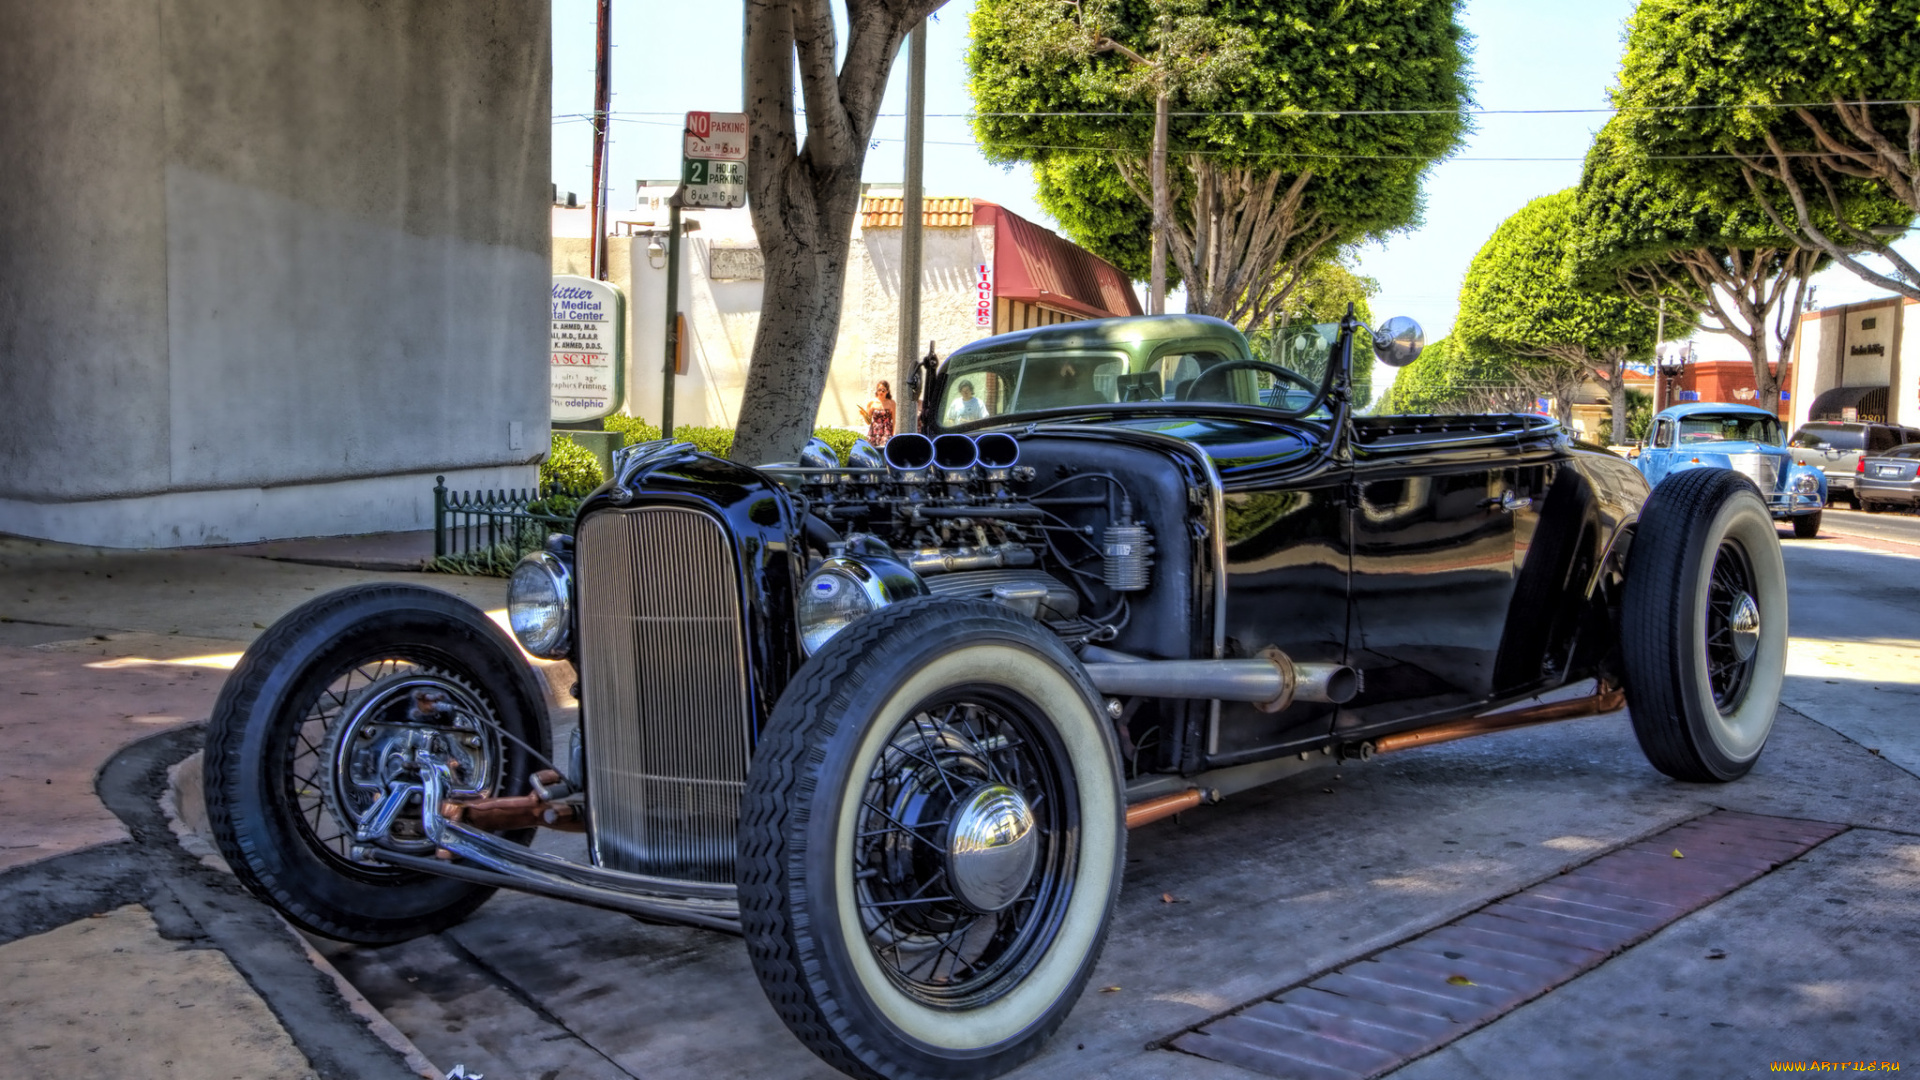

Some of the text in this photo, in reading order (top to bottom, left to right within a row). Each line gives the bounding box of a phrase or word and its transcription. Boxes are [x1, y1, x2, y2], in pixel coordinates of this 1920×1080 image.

[689, 115, 745, 134] NO PARKING
[693, 142, 698, 152] 2
[722, 143, 728, 153] 6
[691, 162, 702, 182] 2
[716, 163, 738, 174] HOUR
[709, 174, 743, 185] PARKING
[691, 189, 697, 200] 8
[719, 191, 726, 201] 6
[552, 283, 594, 300] hittier
[977, 264, 992, 326] LIQUORS
[561, 300, 602, 310] Medical
[551, 310, 605, 320] tal Center
[560, 323, 583, 331] AHMED,
[562, 342, 584, 350] AHMED,
[585, 342, 603, 350] D.D.S.
[577, 381, 607, 391] Printing
